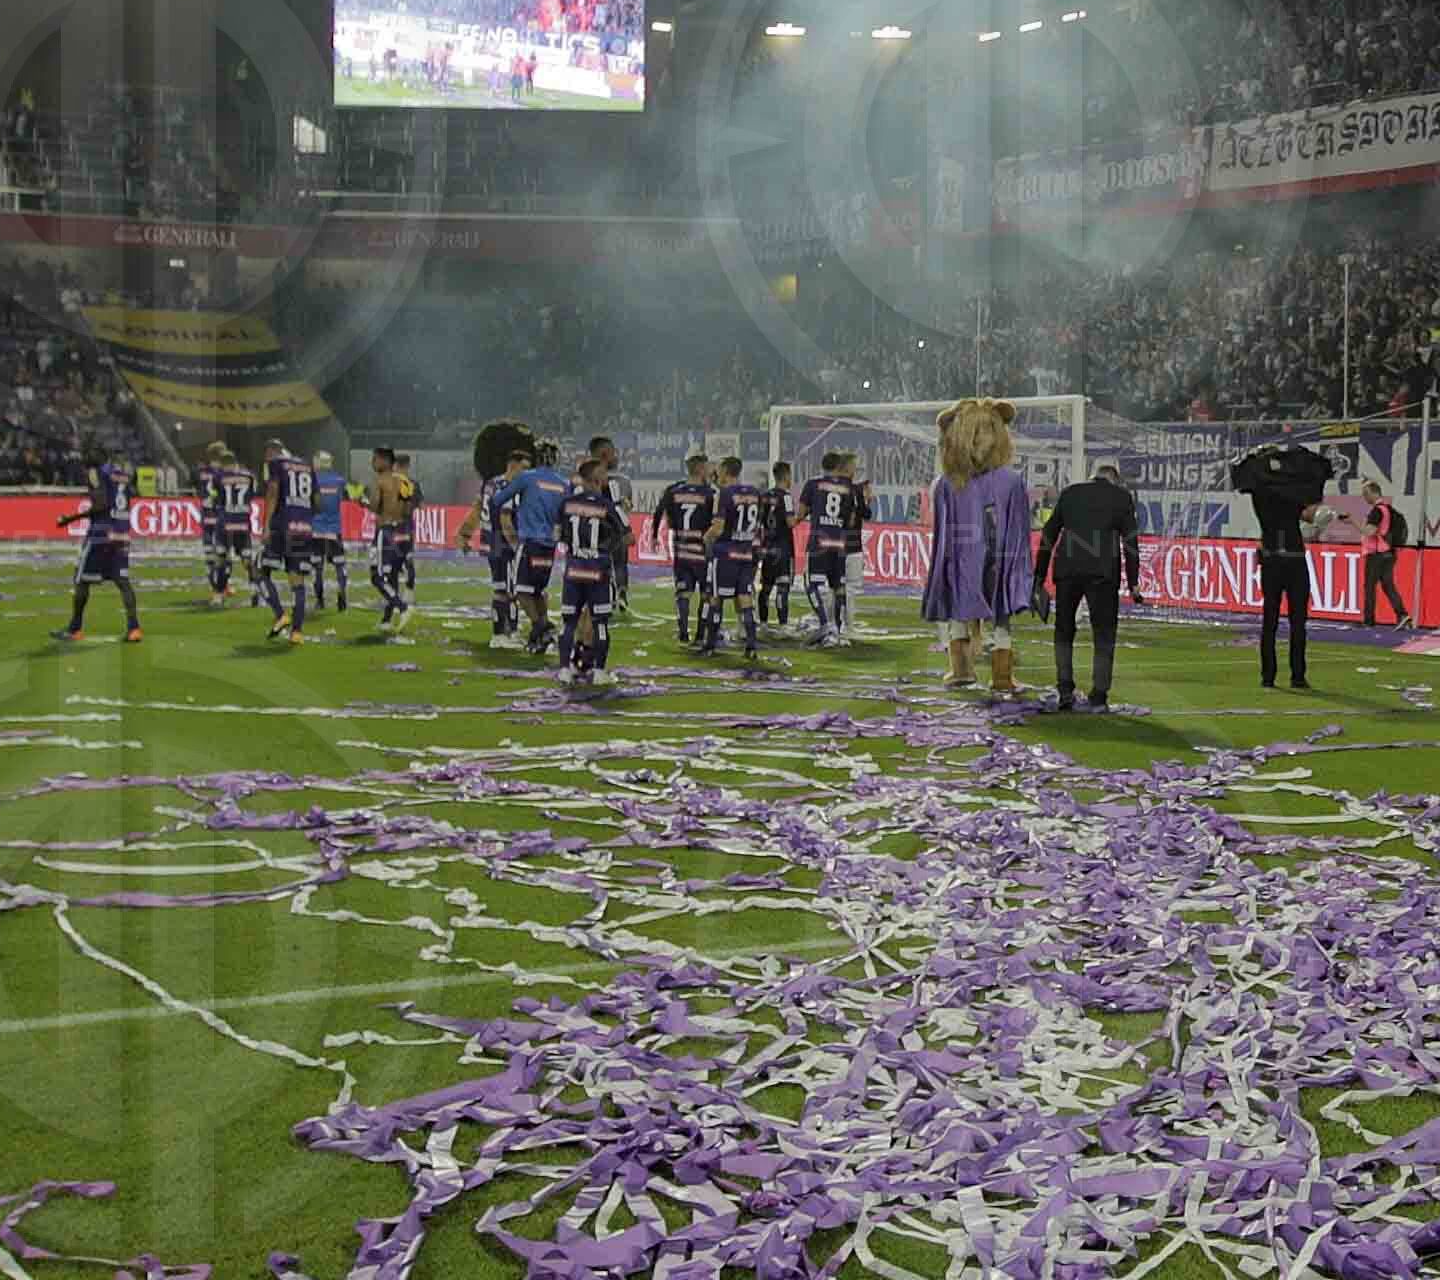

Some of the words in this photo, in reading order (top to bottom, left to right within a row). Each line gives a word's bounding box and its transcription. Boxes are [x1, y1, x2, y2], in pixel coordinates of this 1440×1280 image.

[679, 503, 698, 531] 7
[825, 492, 842, 518] 8
[569, 515, 601, 549] 11
